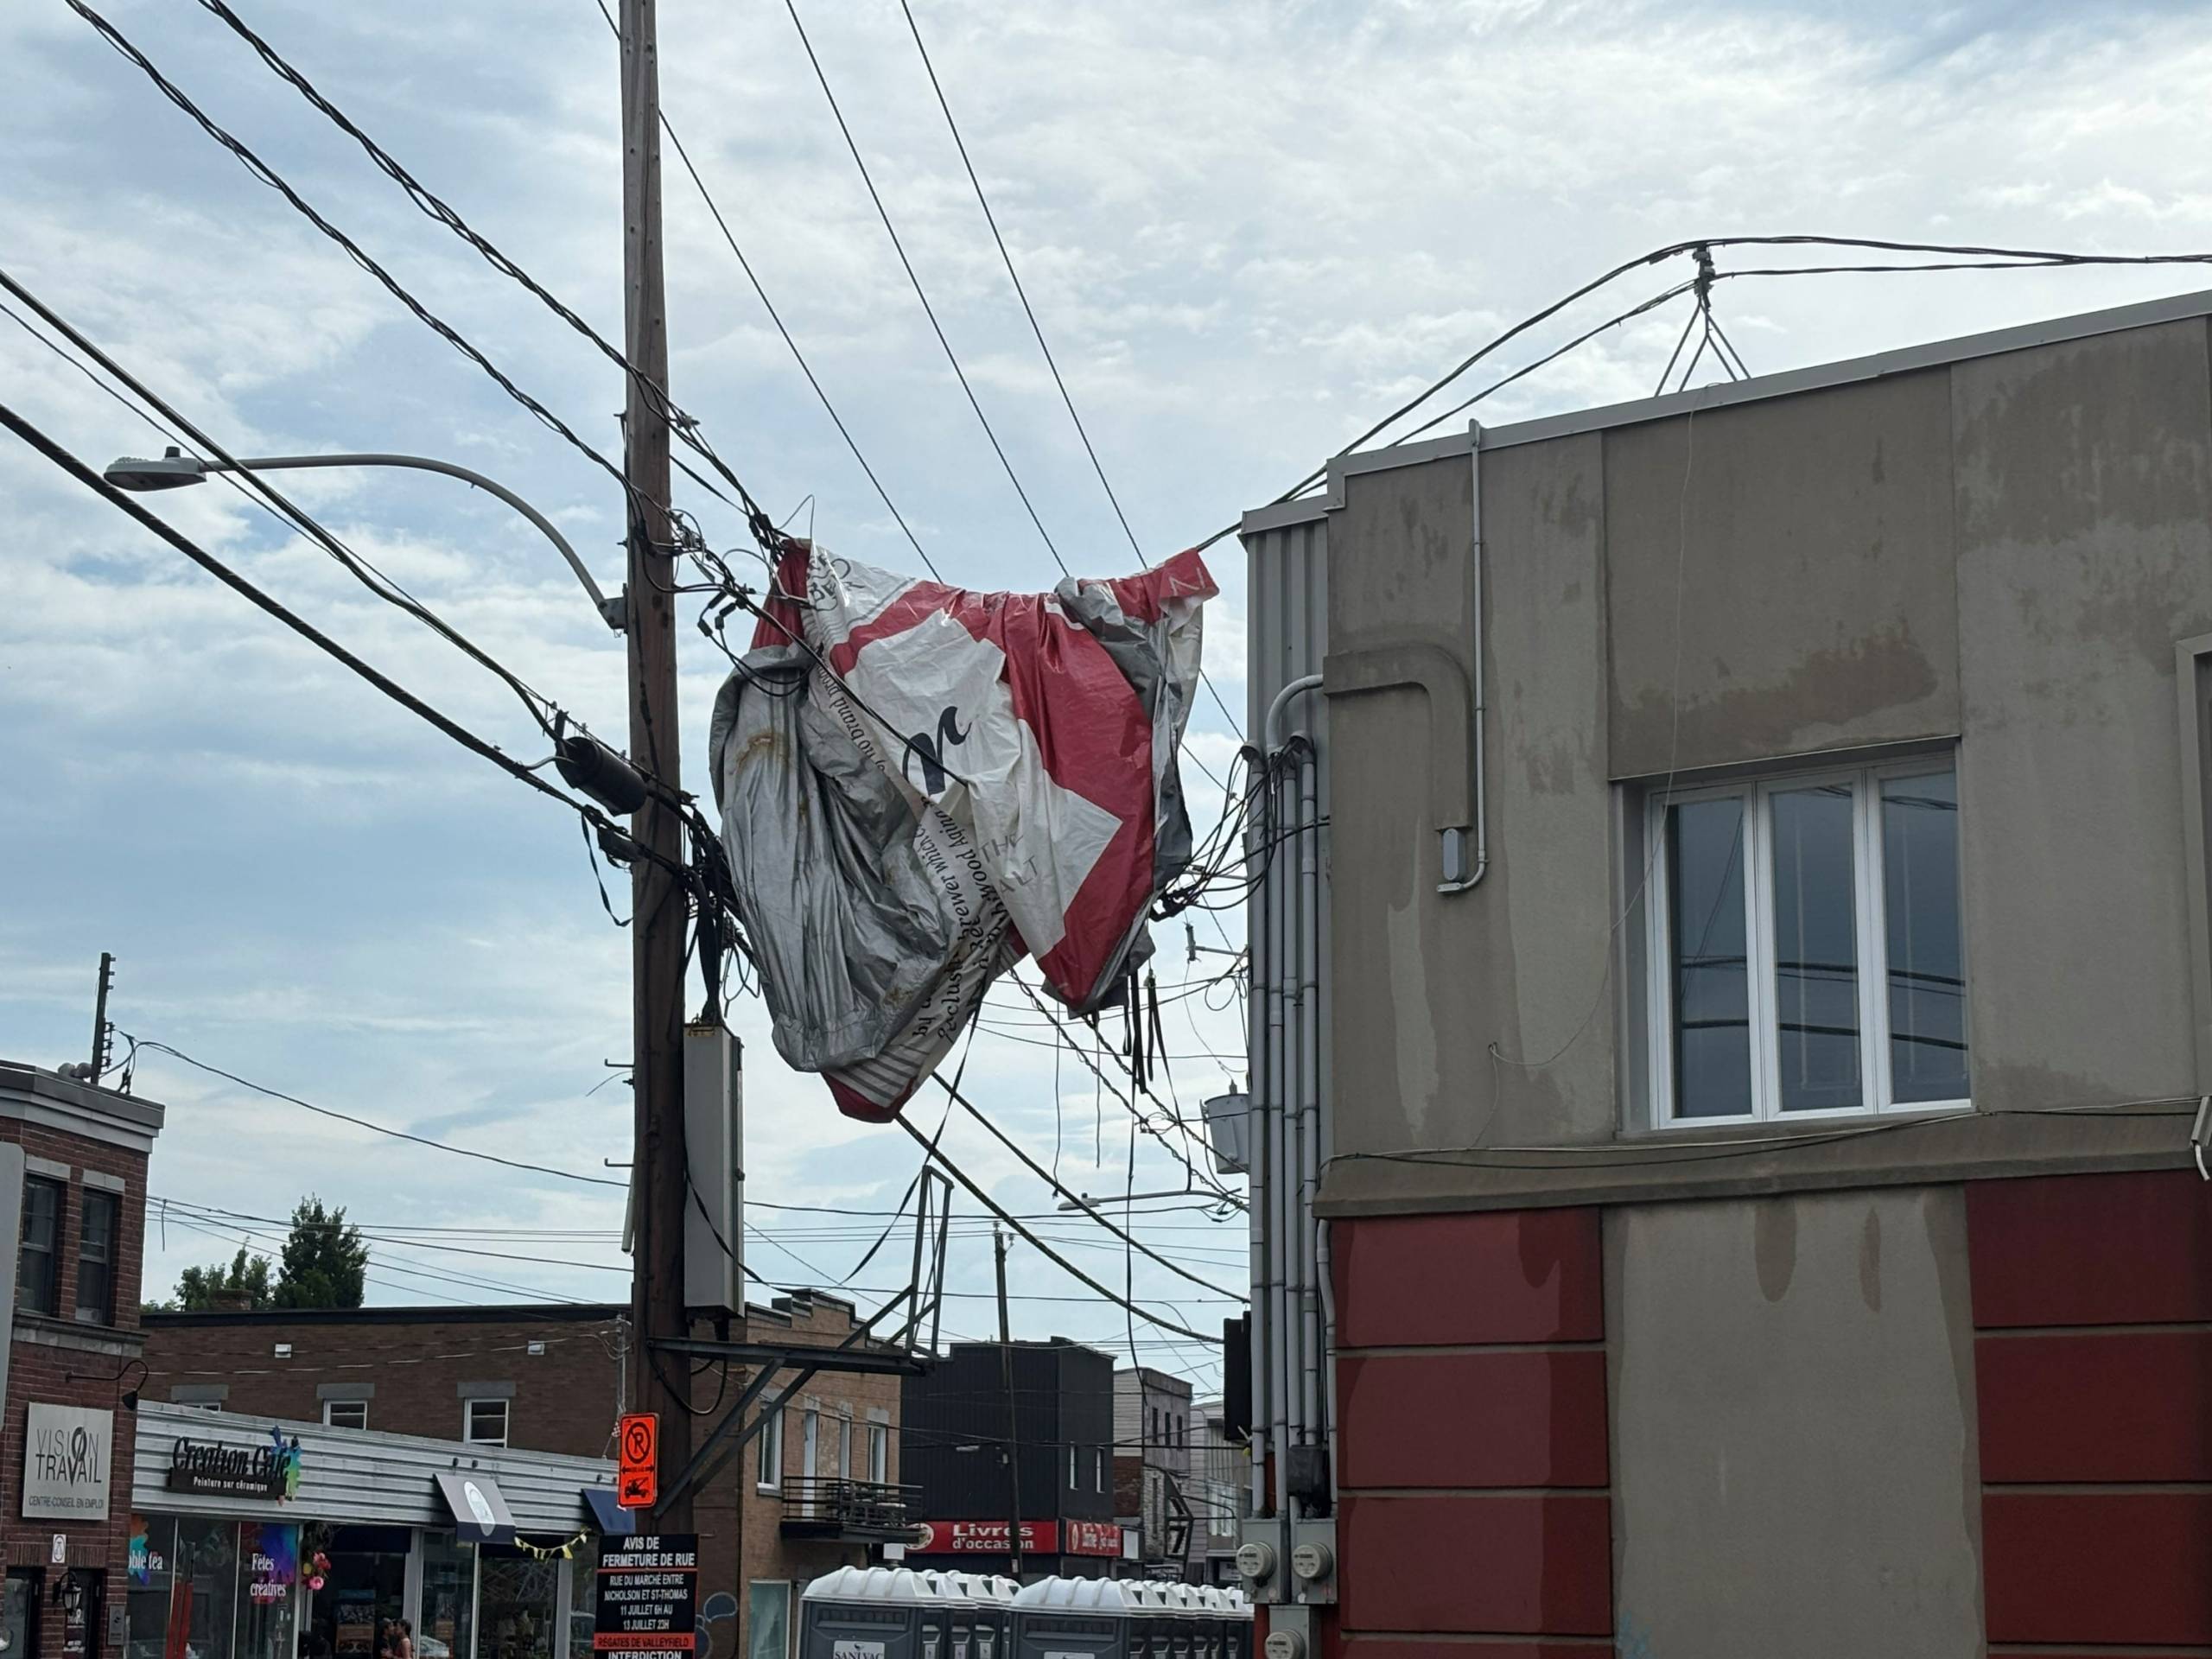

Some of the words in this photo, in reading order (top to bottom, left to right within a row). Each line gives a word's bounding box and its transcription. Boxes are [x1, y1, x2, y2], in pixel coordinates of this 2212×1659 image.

[830, 696, 865, 741] brand
[37, 1427, 99, 1459] VISION
[35, 1453, 102, 1486] TRAVAIL
[194, 1476, 221, 1489] Peinture
[223, 1479, 234, 1490] sur
[236, 1478, 268, 1493] céramique
[623, 1536, 645, 1550] AVIS
[646, 1536, 659, 1549] DE
[952, 1537, 1034, 1549] d'occasn
[602, 1553, 658, 1567] FERMETURE
[660, 1553, 673, 1567] DE
[675, 1553, 695, 1567] RUE
[610, 1575, 623, 1586] RUE
[625, 1575, 633, 1586] DU
[663, 1573, 684, 1585] ENTRE
[605, 1590, 640, 1601] NICHOLSON
[641, 1590, 650, 1600] ET
[651, 1589, 688, 1600] ST-THOMAS
[620, 1605, 627, 1616] 11
[627, 1605, 653, 1615] JUILLET
[664, 1605, 673, 1615] AU
[631, 1618, 656, 1630] JUILLET
[631, 1637, 641, 1648] DE
[642, 1636, 690, 1648] VALLEYFIELD
[608, 1650, 683, 1659] INTERDICTION
